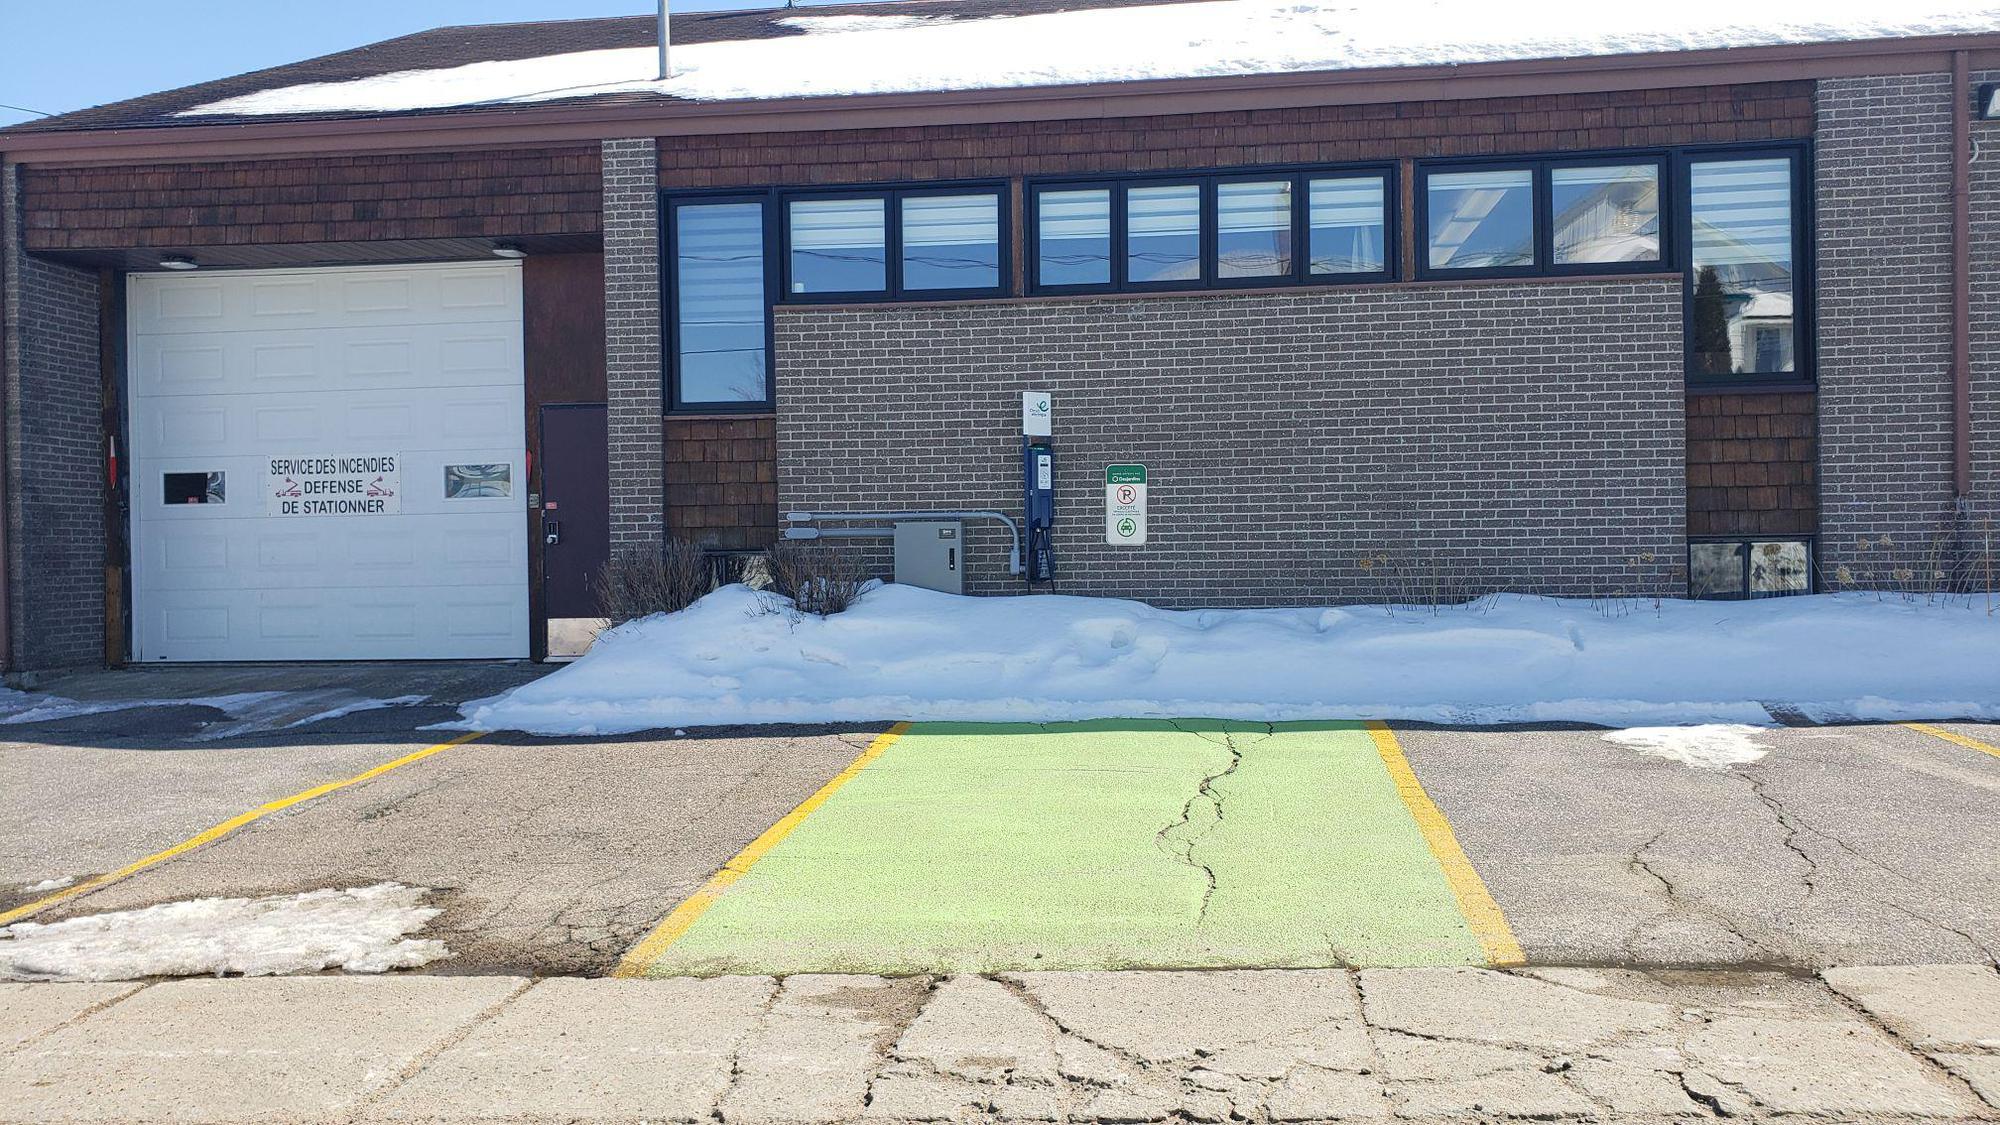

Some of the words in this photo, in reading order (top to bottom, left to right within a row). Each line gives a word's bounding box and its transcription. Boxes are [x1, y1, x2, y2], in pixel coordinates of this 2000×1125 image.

[271, 459, 314, 475] SERVICE
[316, 459, 336, 474] DES
[339, 457, 395, 473] INCENDIES
[304, 480, 363, 494] DEFENSE
[282, 501, 299, 514] DE
[303, 500, 385, 514] STATIONNER
